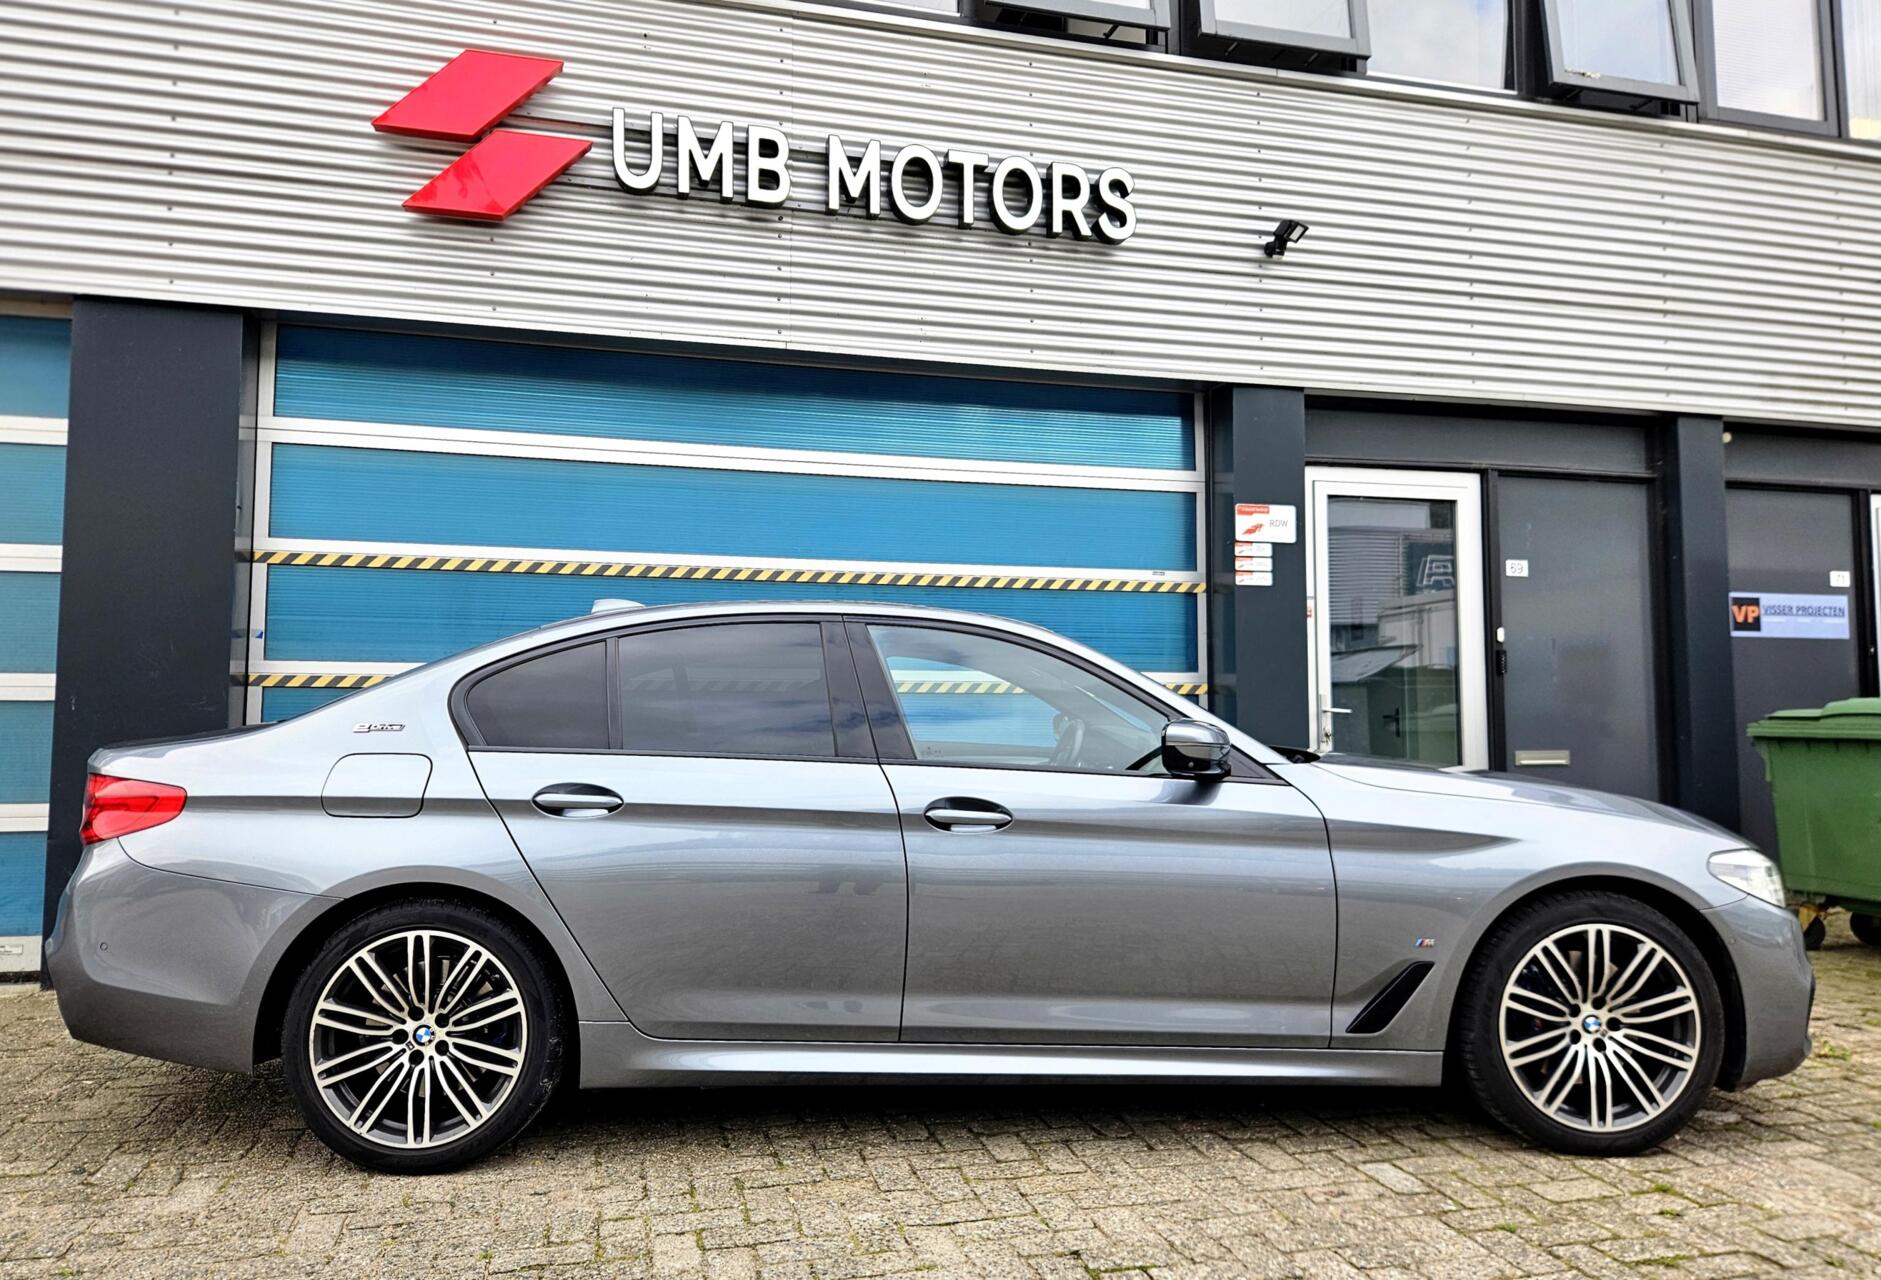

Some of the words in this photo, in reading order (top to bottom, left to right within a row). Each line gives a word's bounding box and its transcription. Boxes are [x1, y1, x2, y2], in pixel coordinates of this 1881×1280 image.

[612, 107, 791, 206] UMB
[827, 134, 1137, 243] MOTORS
[1269, 519, 1289, 528] RDW
[1510, 562, 1524, 575] 69
[1731, 604, 1760, 624] VP
[1763, 604, 1793, 617] VISSER
[1795, 605, 1845, 618] PROJECTEN
